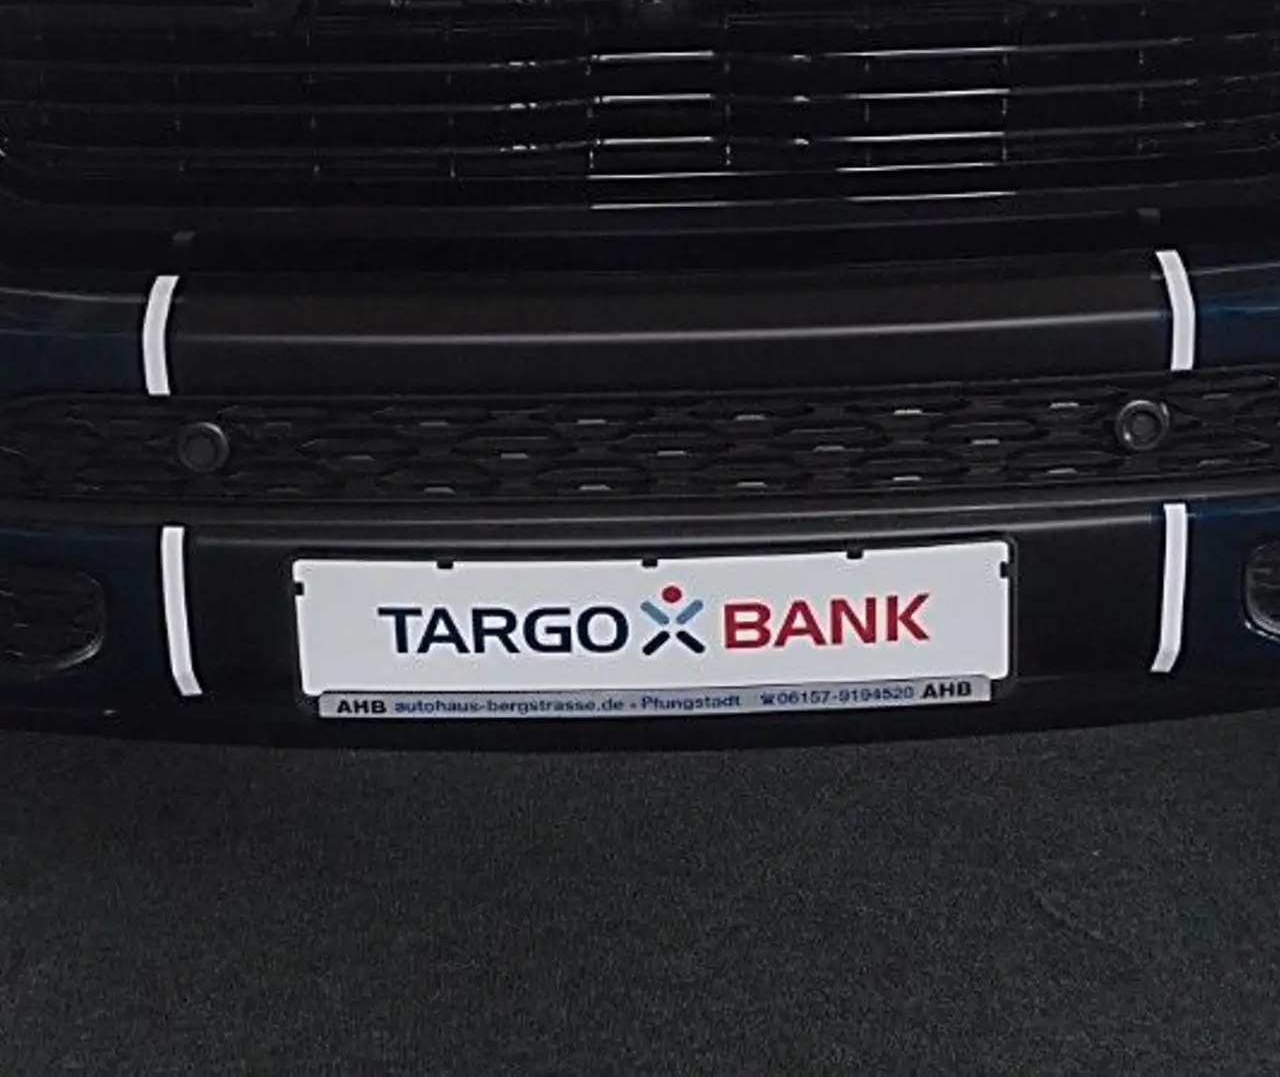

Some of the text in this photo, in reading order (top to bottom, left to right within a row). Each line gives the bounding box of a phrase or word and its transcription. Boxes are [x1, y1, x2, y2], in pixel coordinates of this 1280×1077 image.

[378, 592, 931, 654] TARGO BANK
[336, 699, 388, 714] AHB
[394, 697, 624, 714] autohaus-bergstrasse.de
[922, 680, 973, 700] AHB
